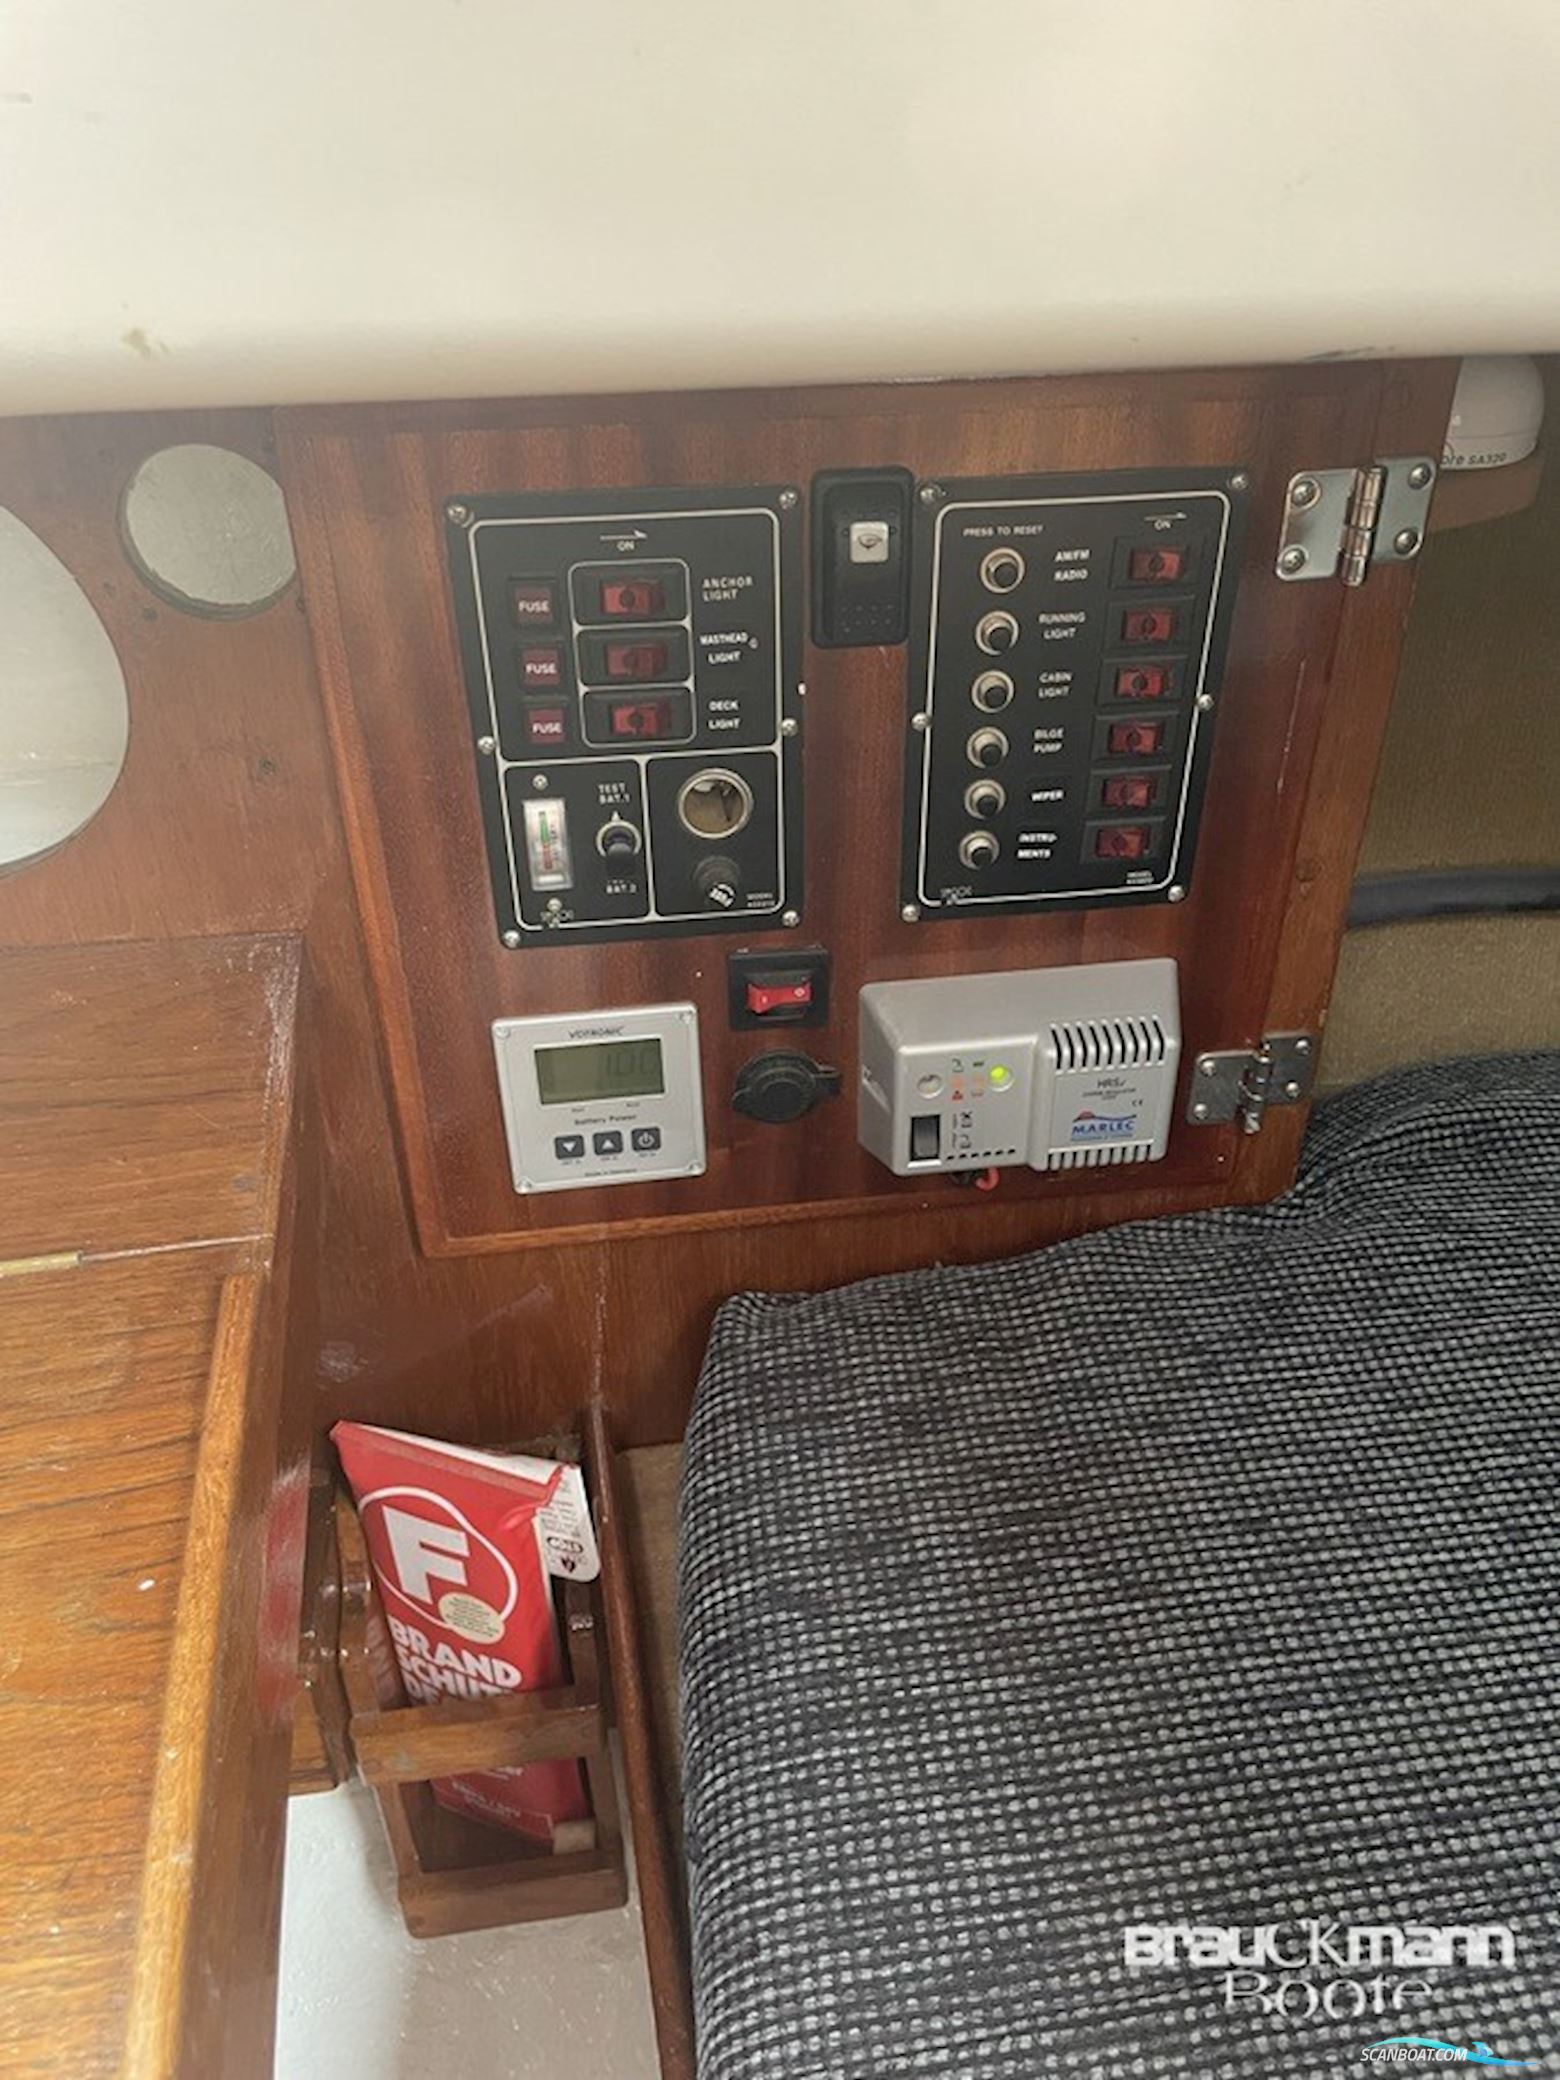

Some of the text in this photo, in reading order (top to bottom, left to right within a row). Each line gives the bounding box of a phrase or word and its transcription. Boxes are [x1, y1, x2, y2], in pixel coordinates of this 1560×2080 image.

[962, 524, 1044, 537] PRESS TO RESET
[1154, 520, 1172, 531] ON
[616, 541, 636, 552] ON
[1053, 568, 1089, 582] RADIO
[702, 576, 754, 590] ANCHOR
[702, 589, 739, 602] LIGHT
[518, 600, 550, 614] FUSE
[1038, 611, 1087, 626] RUNNING
[700, 632, 749, 646] MASTHEAD
[1043, 627, 1077, 640] LIGHT
[707, 651, 742, 665] LIGHT
[525, 662, 558, 675] FUSE
[1039, 672, 1074, 685] CABIN
[1038, 686, 1071, 699] LIGHT
[708, 701, 739, 712] DECK
[532, 721, 563, 735] FUSE
[707, 719, 741, 731] LIGHT
[1033, 742, 1064, 755] PUMP
[598, 782, 626, 794] TEST
[1031, 789, 1065, 802] WIPER
[1017, 848, 1051, 860] MENTS
[1072, 1119, 1136, 1135] MARLEC
[382, 1505, 470, 1604] F
[387, 1614, 522, 1688] BRAND
